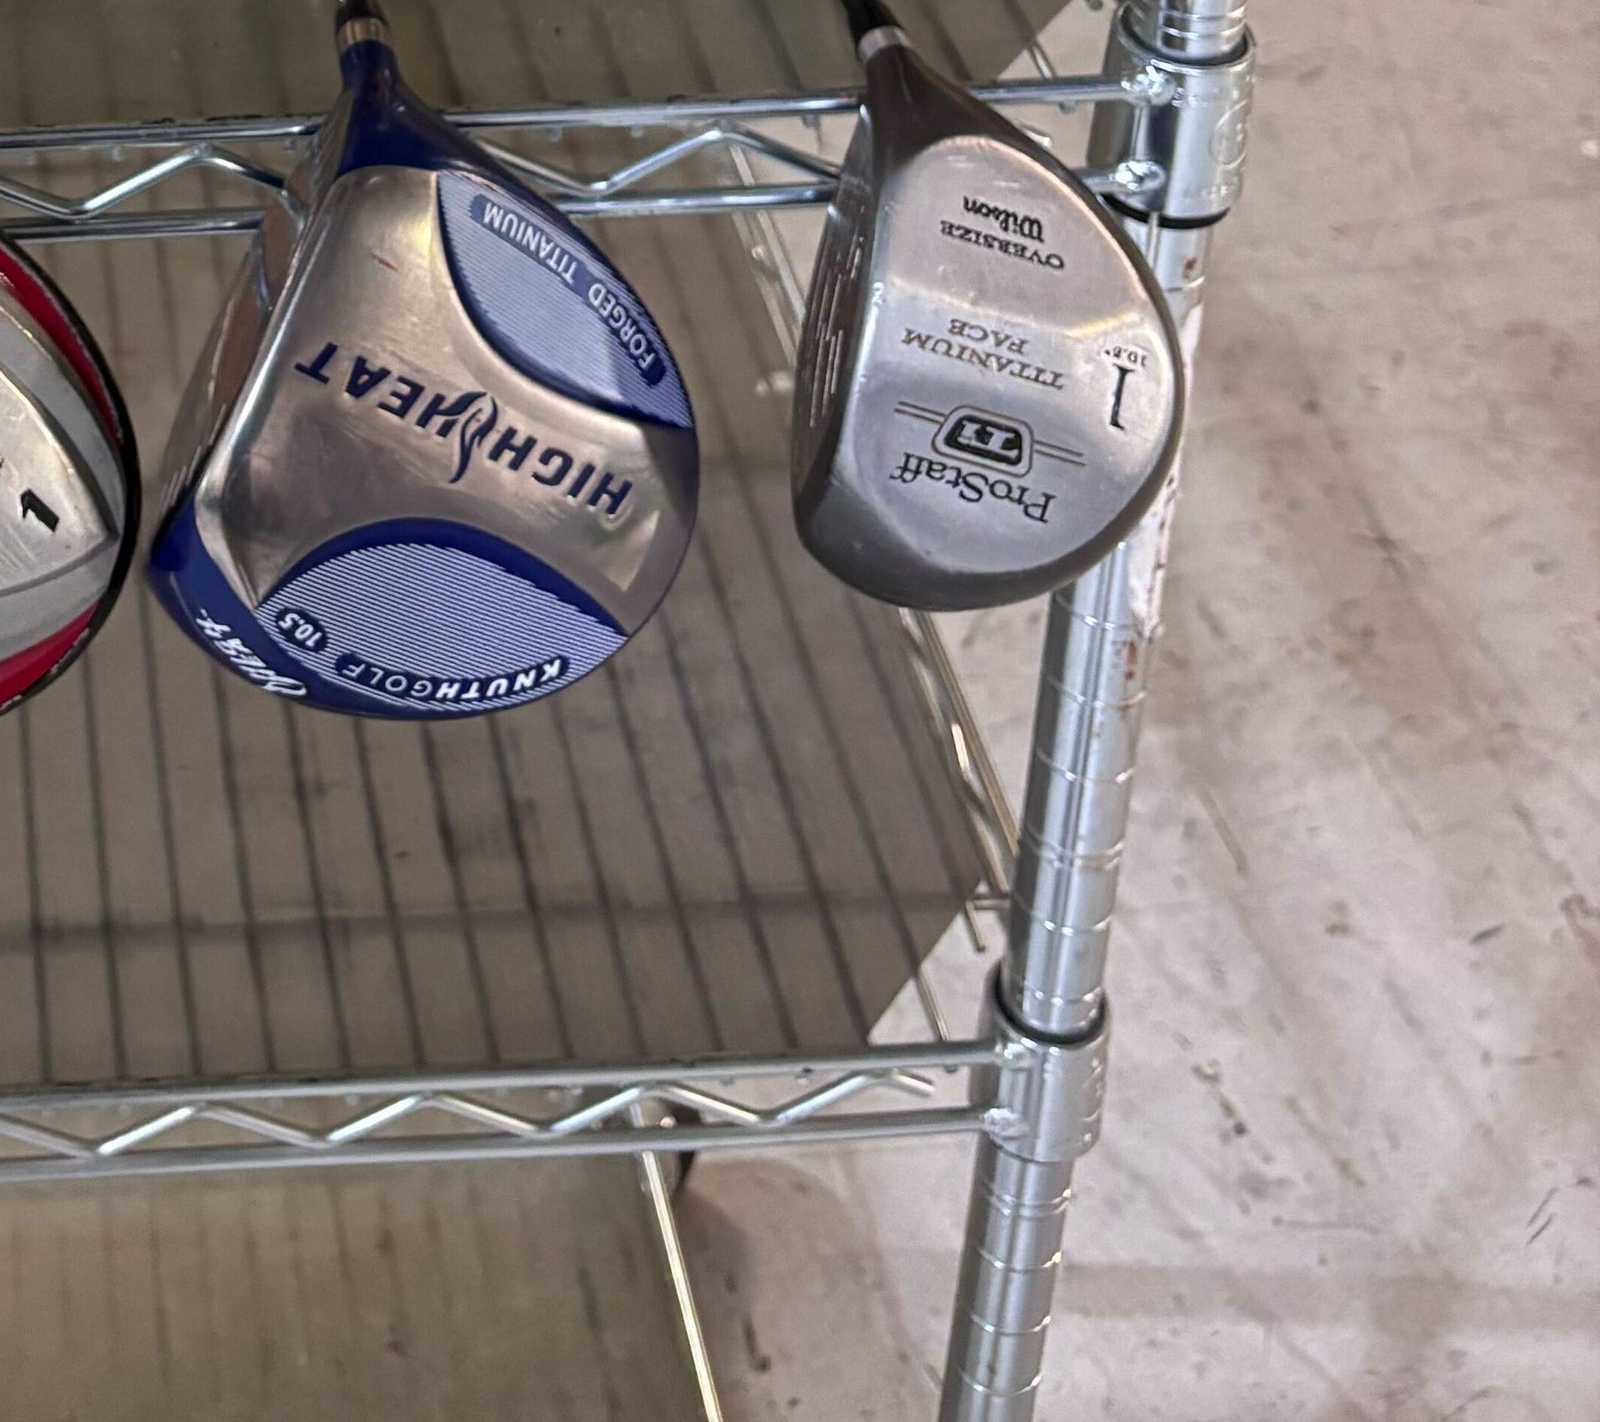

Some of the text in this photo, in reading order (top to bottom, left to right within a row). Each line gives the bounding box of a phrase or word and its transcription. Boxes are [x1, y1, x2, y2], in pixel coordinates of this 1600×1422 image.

[939, 219, 1064, 270] OVERSIZE
[963, 196, 1045, 244] Wilson
[483, 202, 656, 372] FORGED TITANIUM
[903, 329, 1064, 390] TITANIUM
[949, 318, 1030, 355] FACE
[1109, 365, 1136, 431] 1
[295, 342, 632, 517] HIGH HEAT
[20, 489, 60, 533] 1
[891, 452, 1057, 523] ProStaff
[278, 612, 321, 648] 10.5
